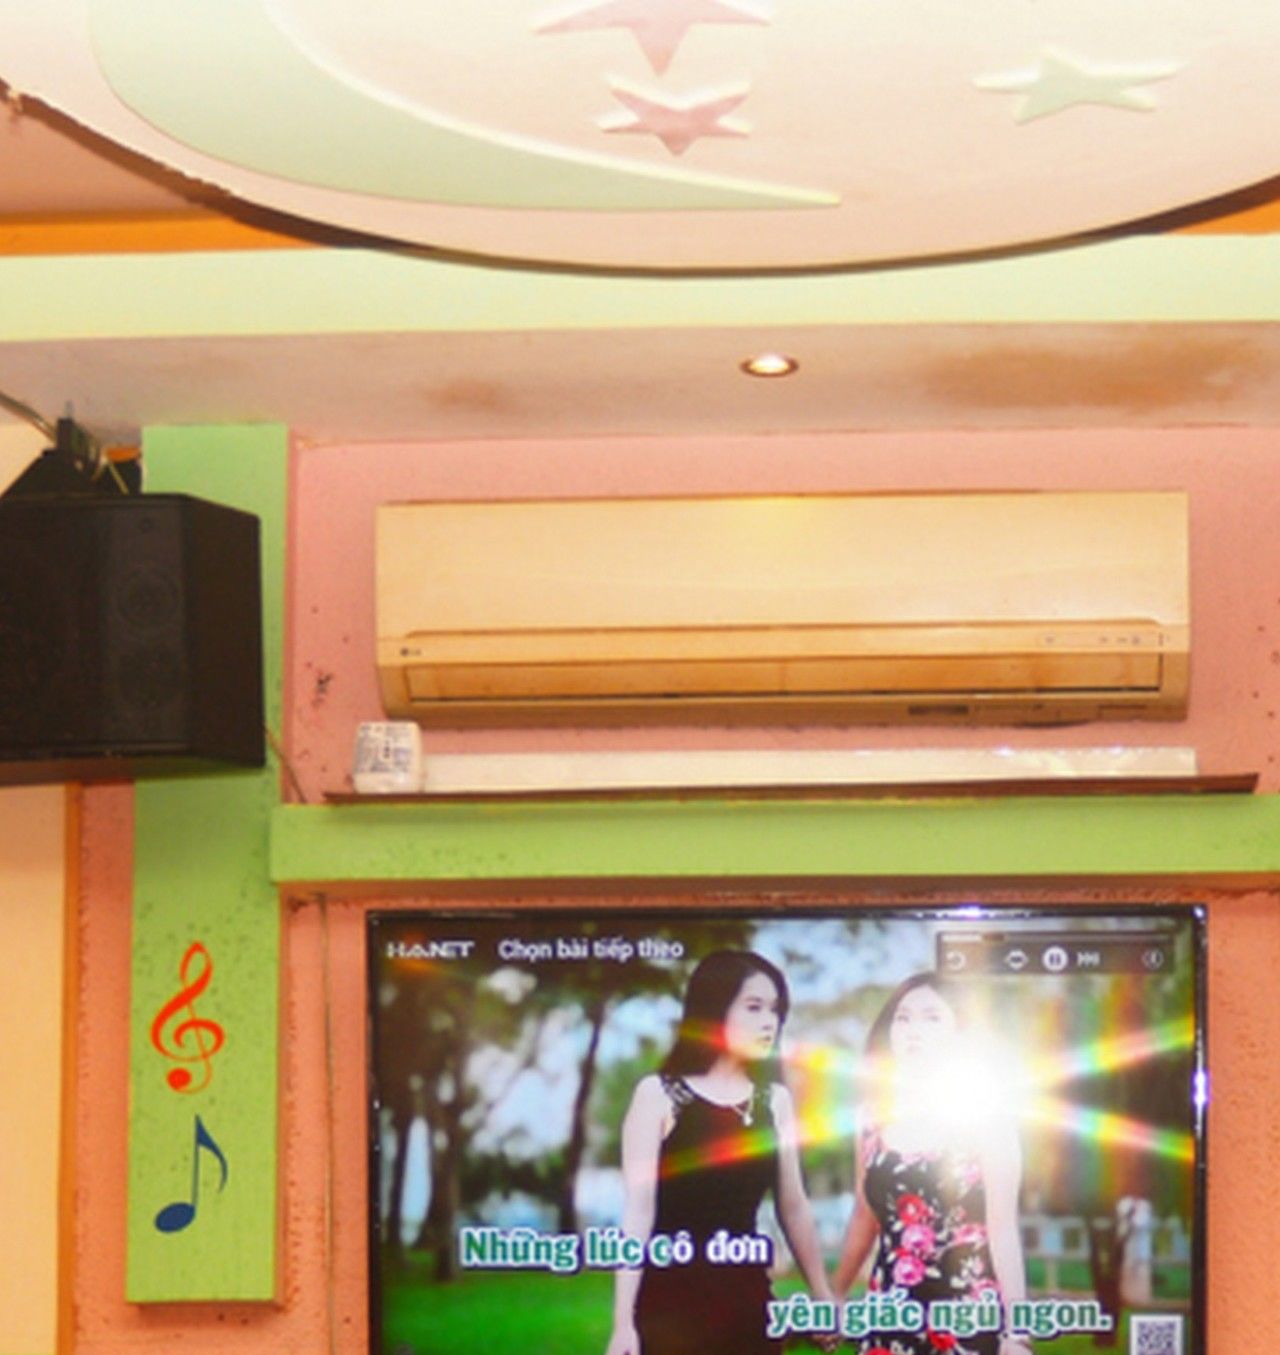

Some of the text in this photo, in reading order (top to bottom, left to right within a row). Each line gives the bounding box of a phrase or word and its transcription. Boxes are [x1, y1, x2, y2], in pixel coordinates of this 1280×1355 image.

[386, 940, 475, 959] HANET
[498, 936, 684, 963] Chọn bài tiếp theo
[461, 1227, 770, 1271] Những lúc cô đơn
[768, 1288, 1114, 1338] yên giấc ngủ ngon.
